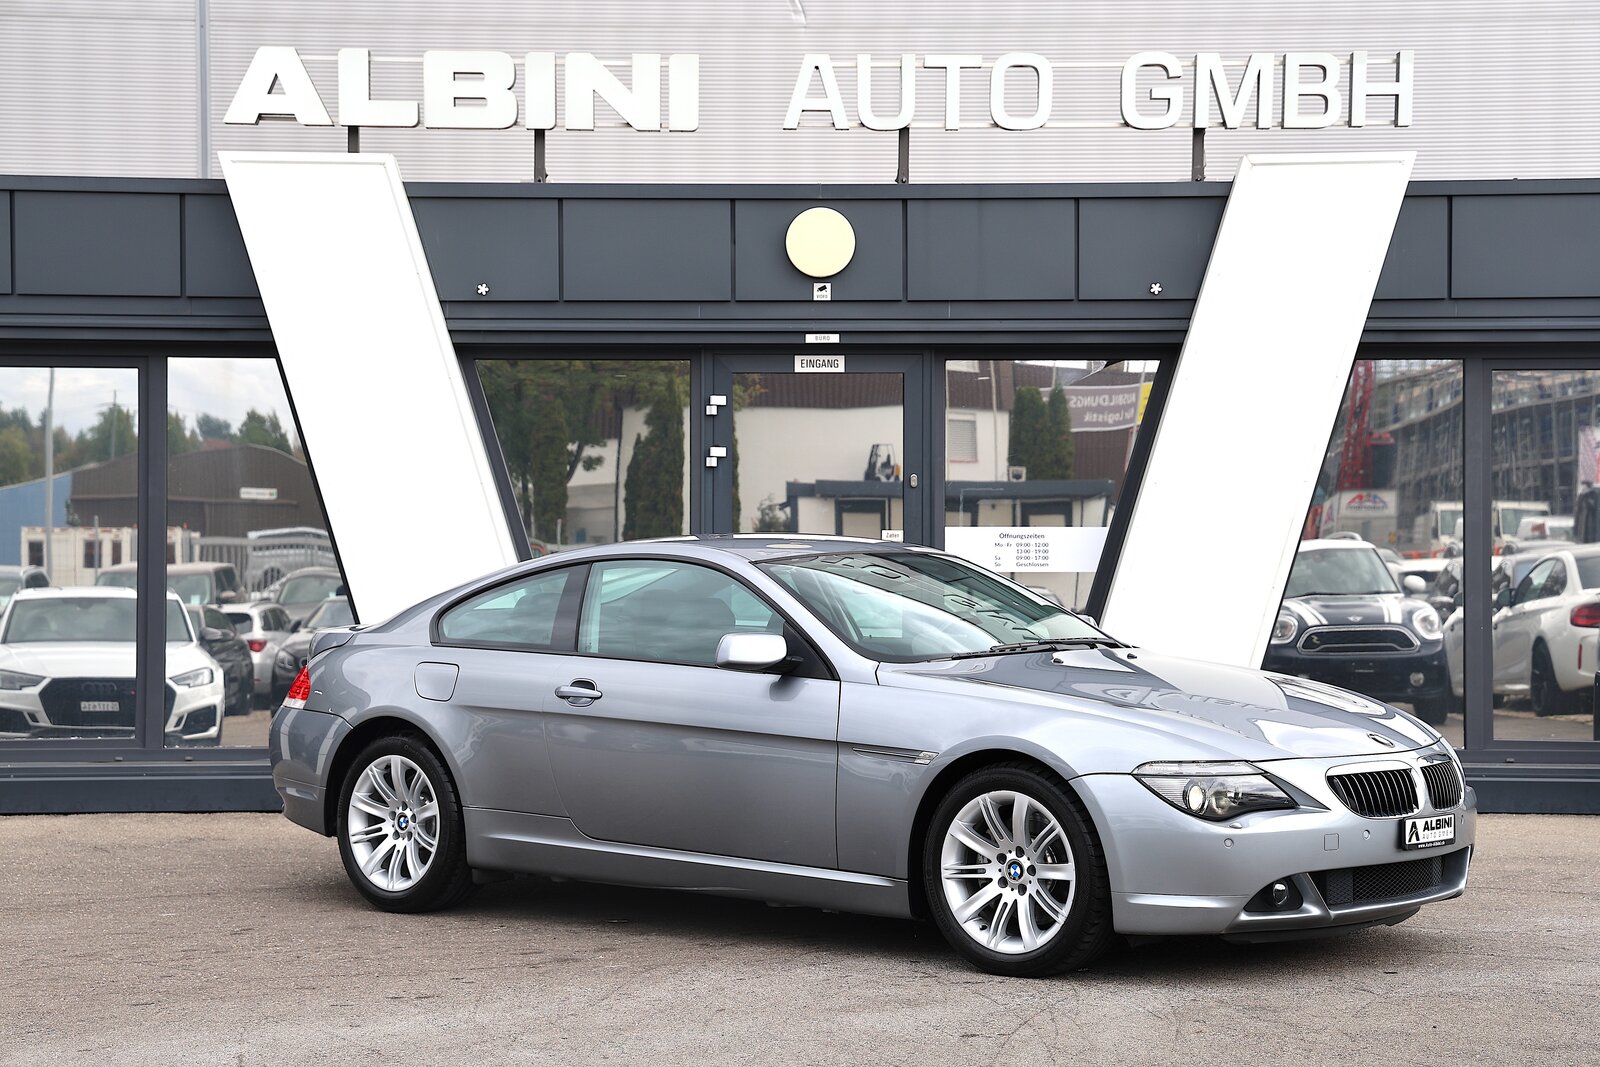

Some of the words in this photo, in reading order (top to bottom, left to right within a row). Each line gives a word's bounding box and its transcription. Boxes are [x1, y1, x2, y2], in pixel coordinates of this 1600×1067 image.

[223, 46, 700, 132] ALBINI
[783, 51, 1054, 131] AUTO
[1120, 50, 1415, 130] GMBH
[800, 359, 839, 369] EINGANG
[1423, 816, 1452, 832] ALBINI
[1422, 831, 1437, 840] AUTO
